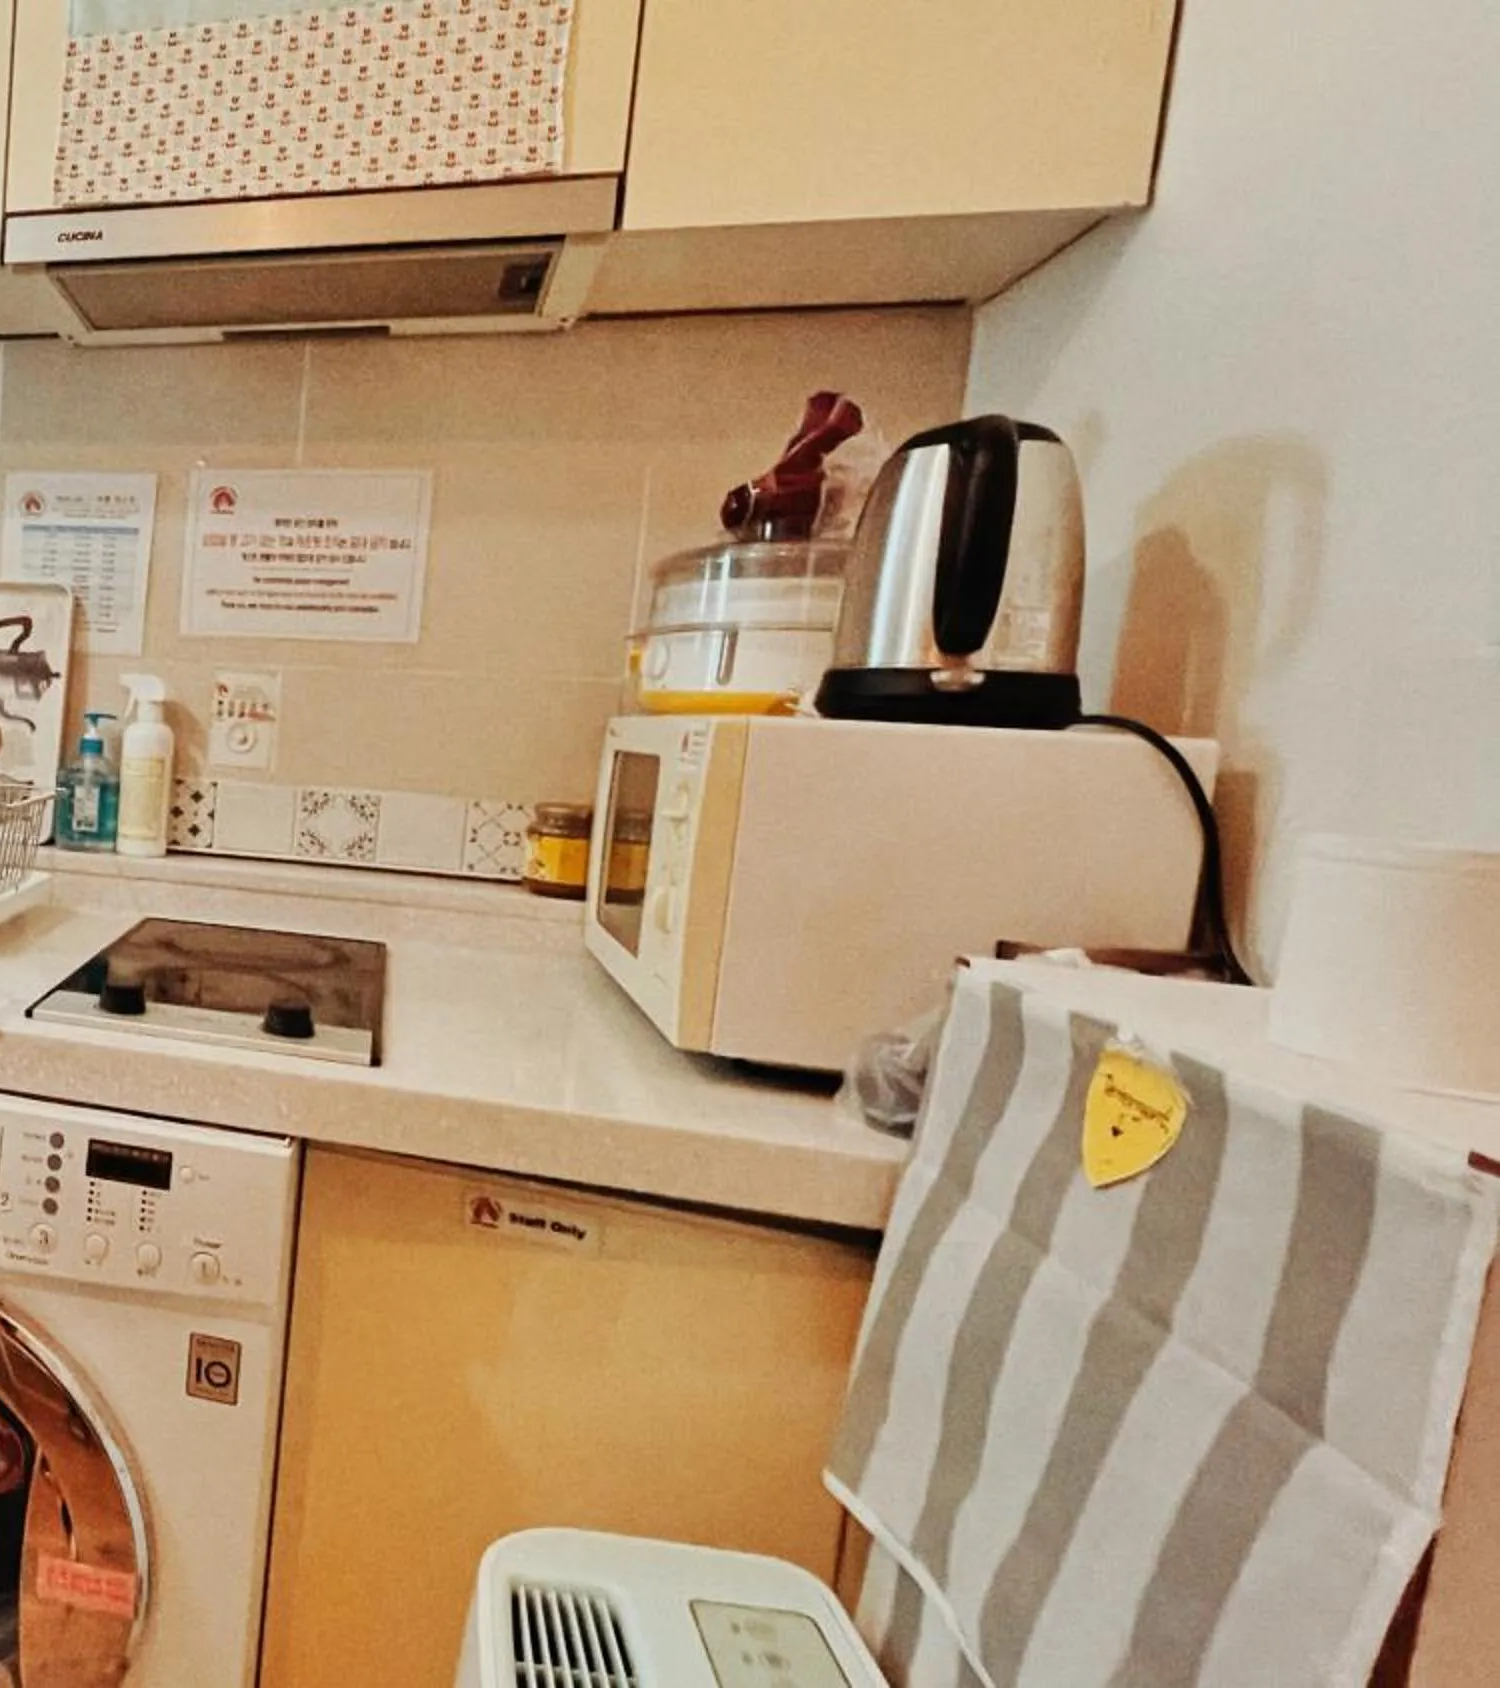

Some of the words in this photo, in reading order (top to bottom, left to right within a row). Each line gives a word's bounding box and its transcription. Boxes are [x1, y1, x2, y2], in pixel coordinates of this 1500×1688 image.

[57, 230, 103, 243] CUCINA
[508, 1211, 546, 1229] Staff
[550, 1221, 588, 1240] Only
